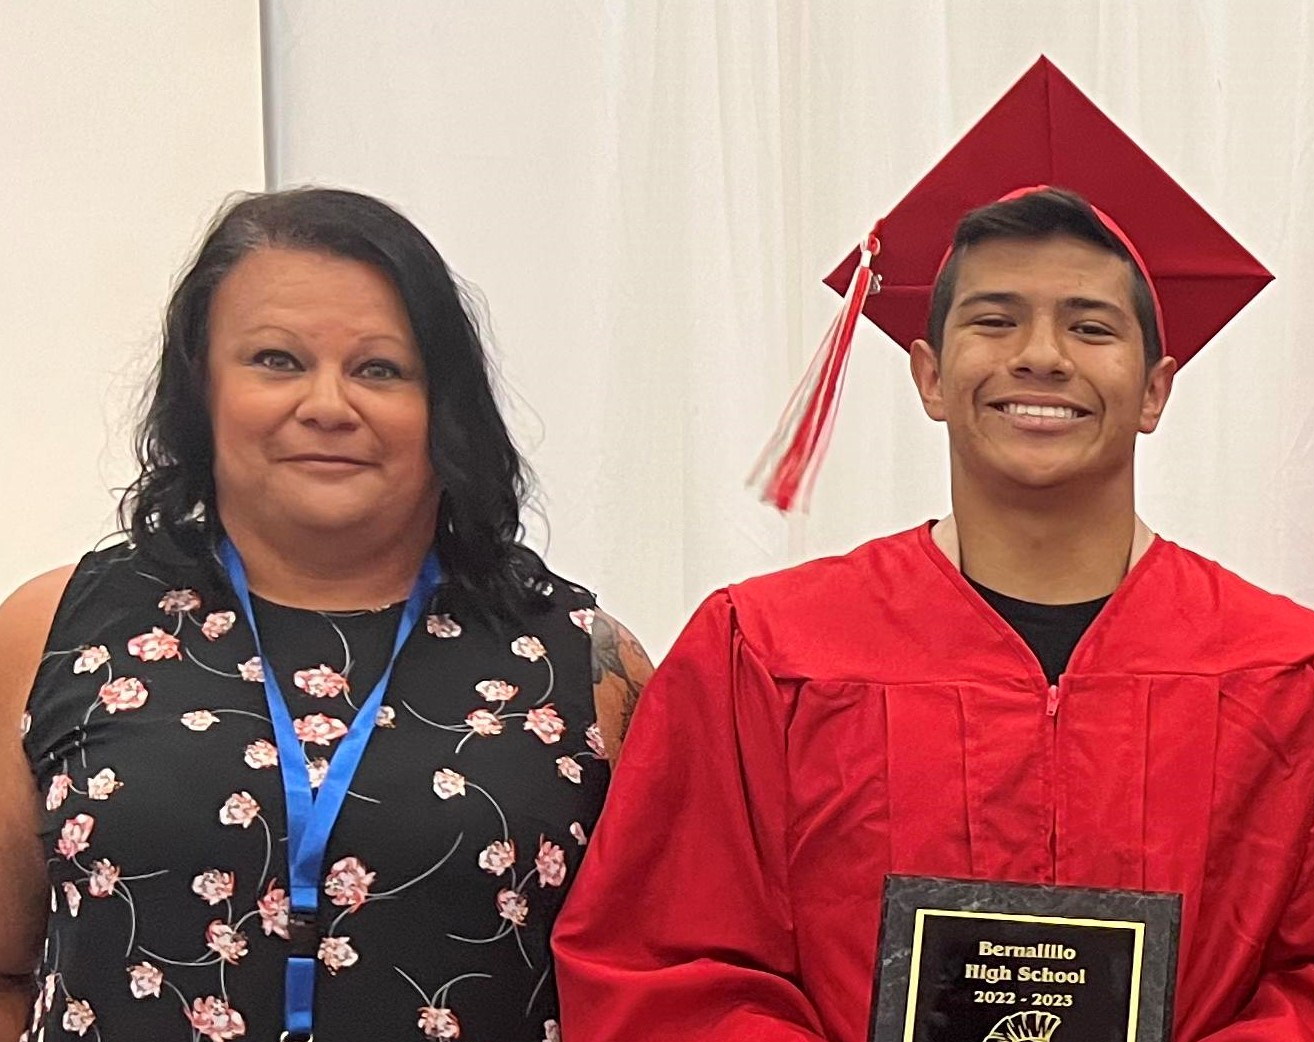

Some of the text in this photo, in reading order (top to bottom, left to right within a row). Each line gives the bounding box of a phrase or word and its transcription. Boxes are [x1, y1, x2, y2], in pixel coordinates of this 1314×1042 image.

[979, 941, 1077, 960] Bernalillo
[965, 963, 1086, 984] High School
[974, 990, 1017, 1005] 2022
[1031, 993, 1074, 1007] 2023
